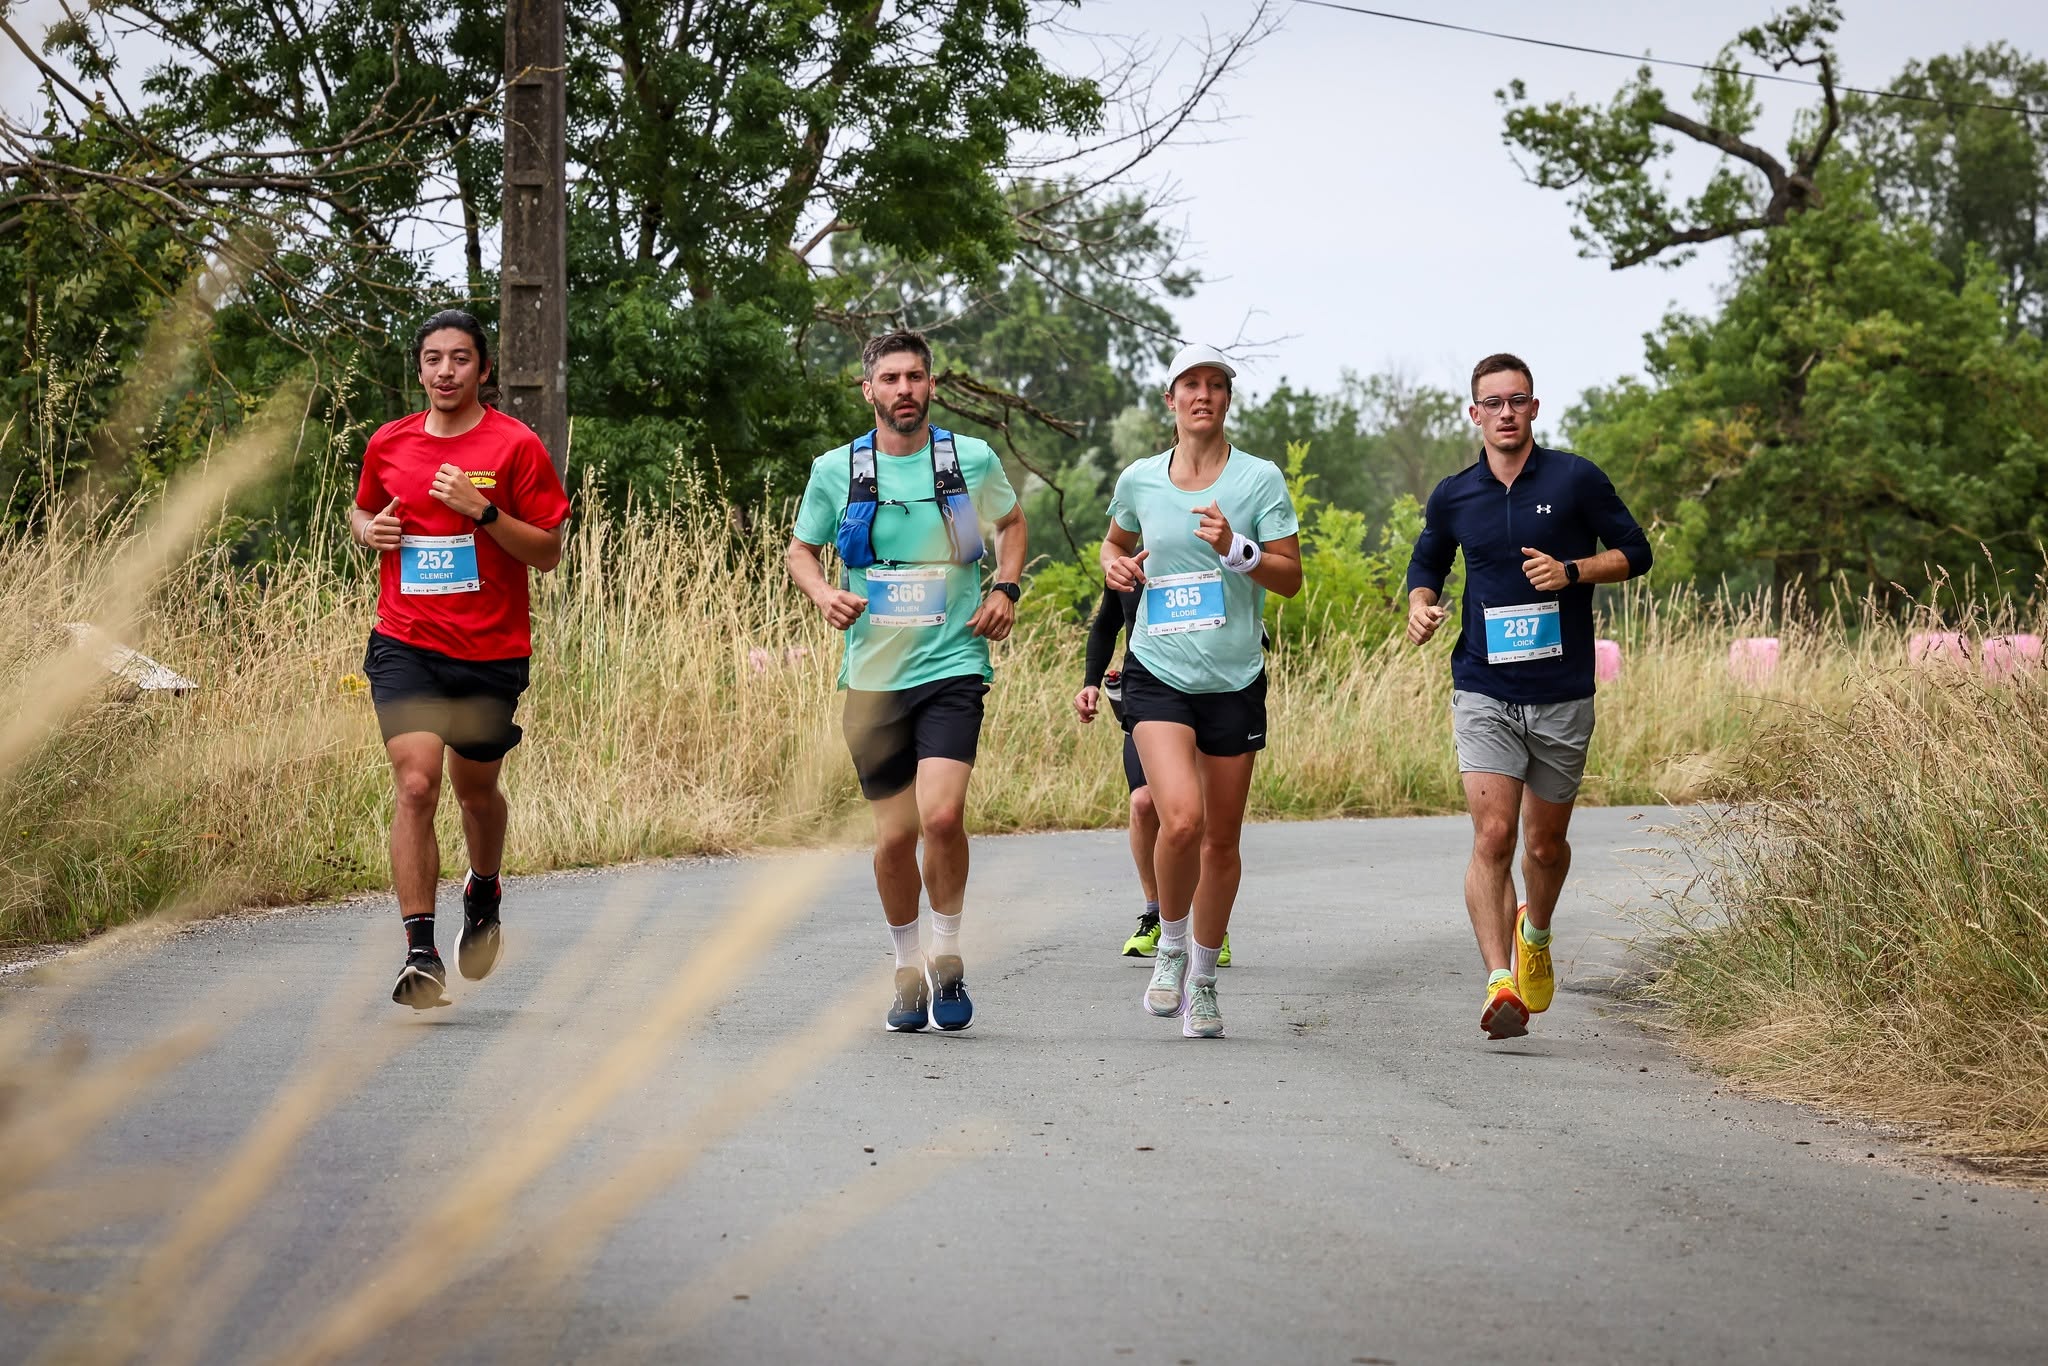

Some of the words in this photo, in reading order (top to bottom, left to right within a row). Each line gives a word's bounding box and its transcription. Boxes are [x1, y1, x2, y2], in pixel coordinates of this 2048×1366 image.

[417, 550, 455, 569] 252
[419, 572, 454, 580] CLEMENT
[887, 583, 926, 603] 366
[1165, 586, 1202, 608] 365
[894, 605, 920, 613] JULIEN
[1171, 608, 1197, 618] ELODIE
[1503, 617, 1540, 638] 287
[1512, 639, 1535, 647] LOICK
